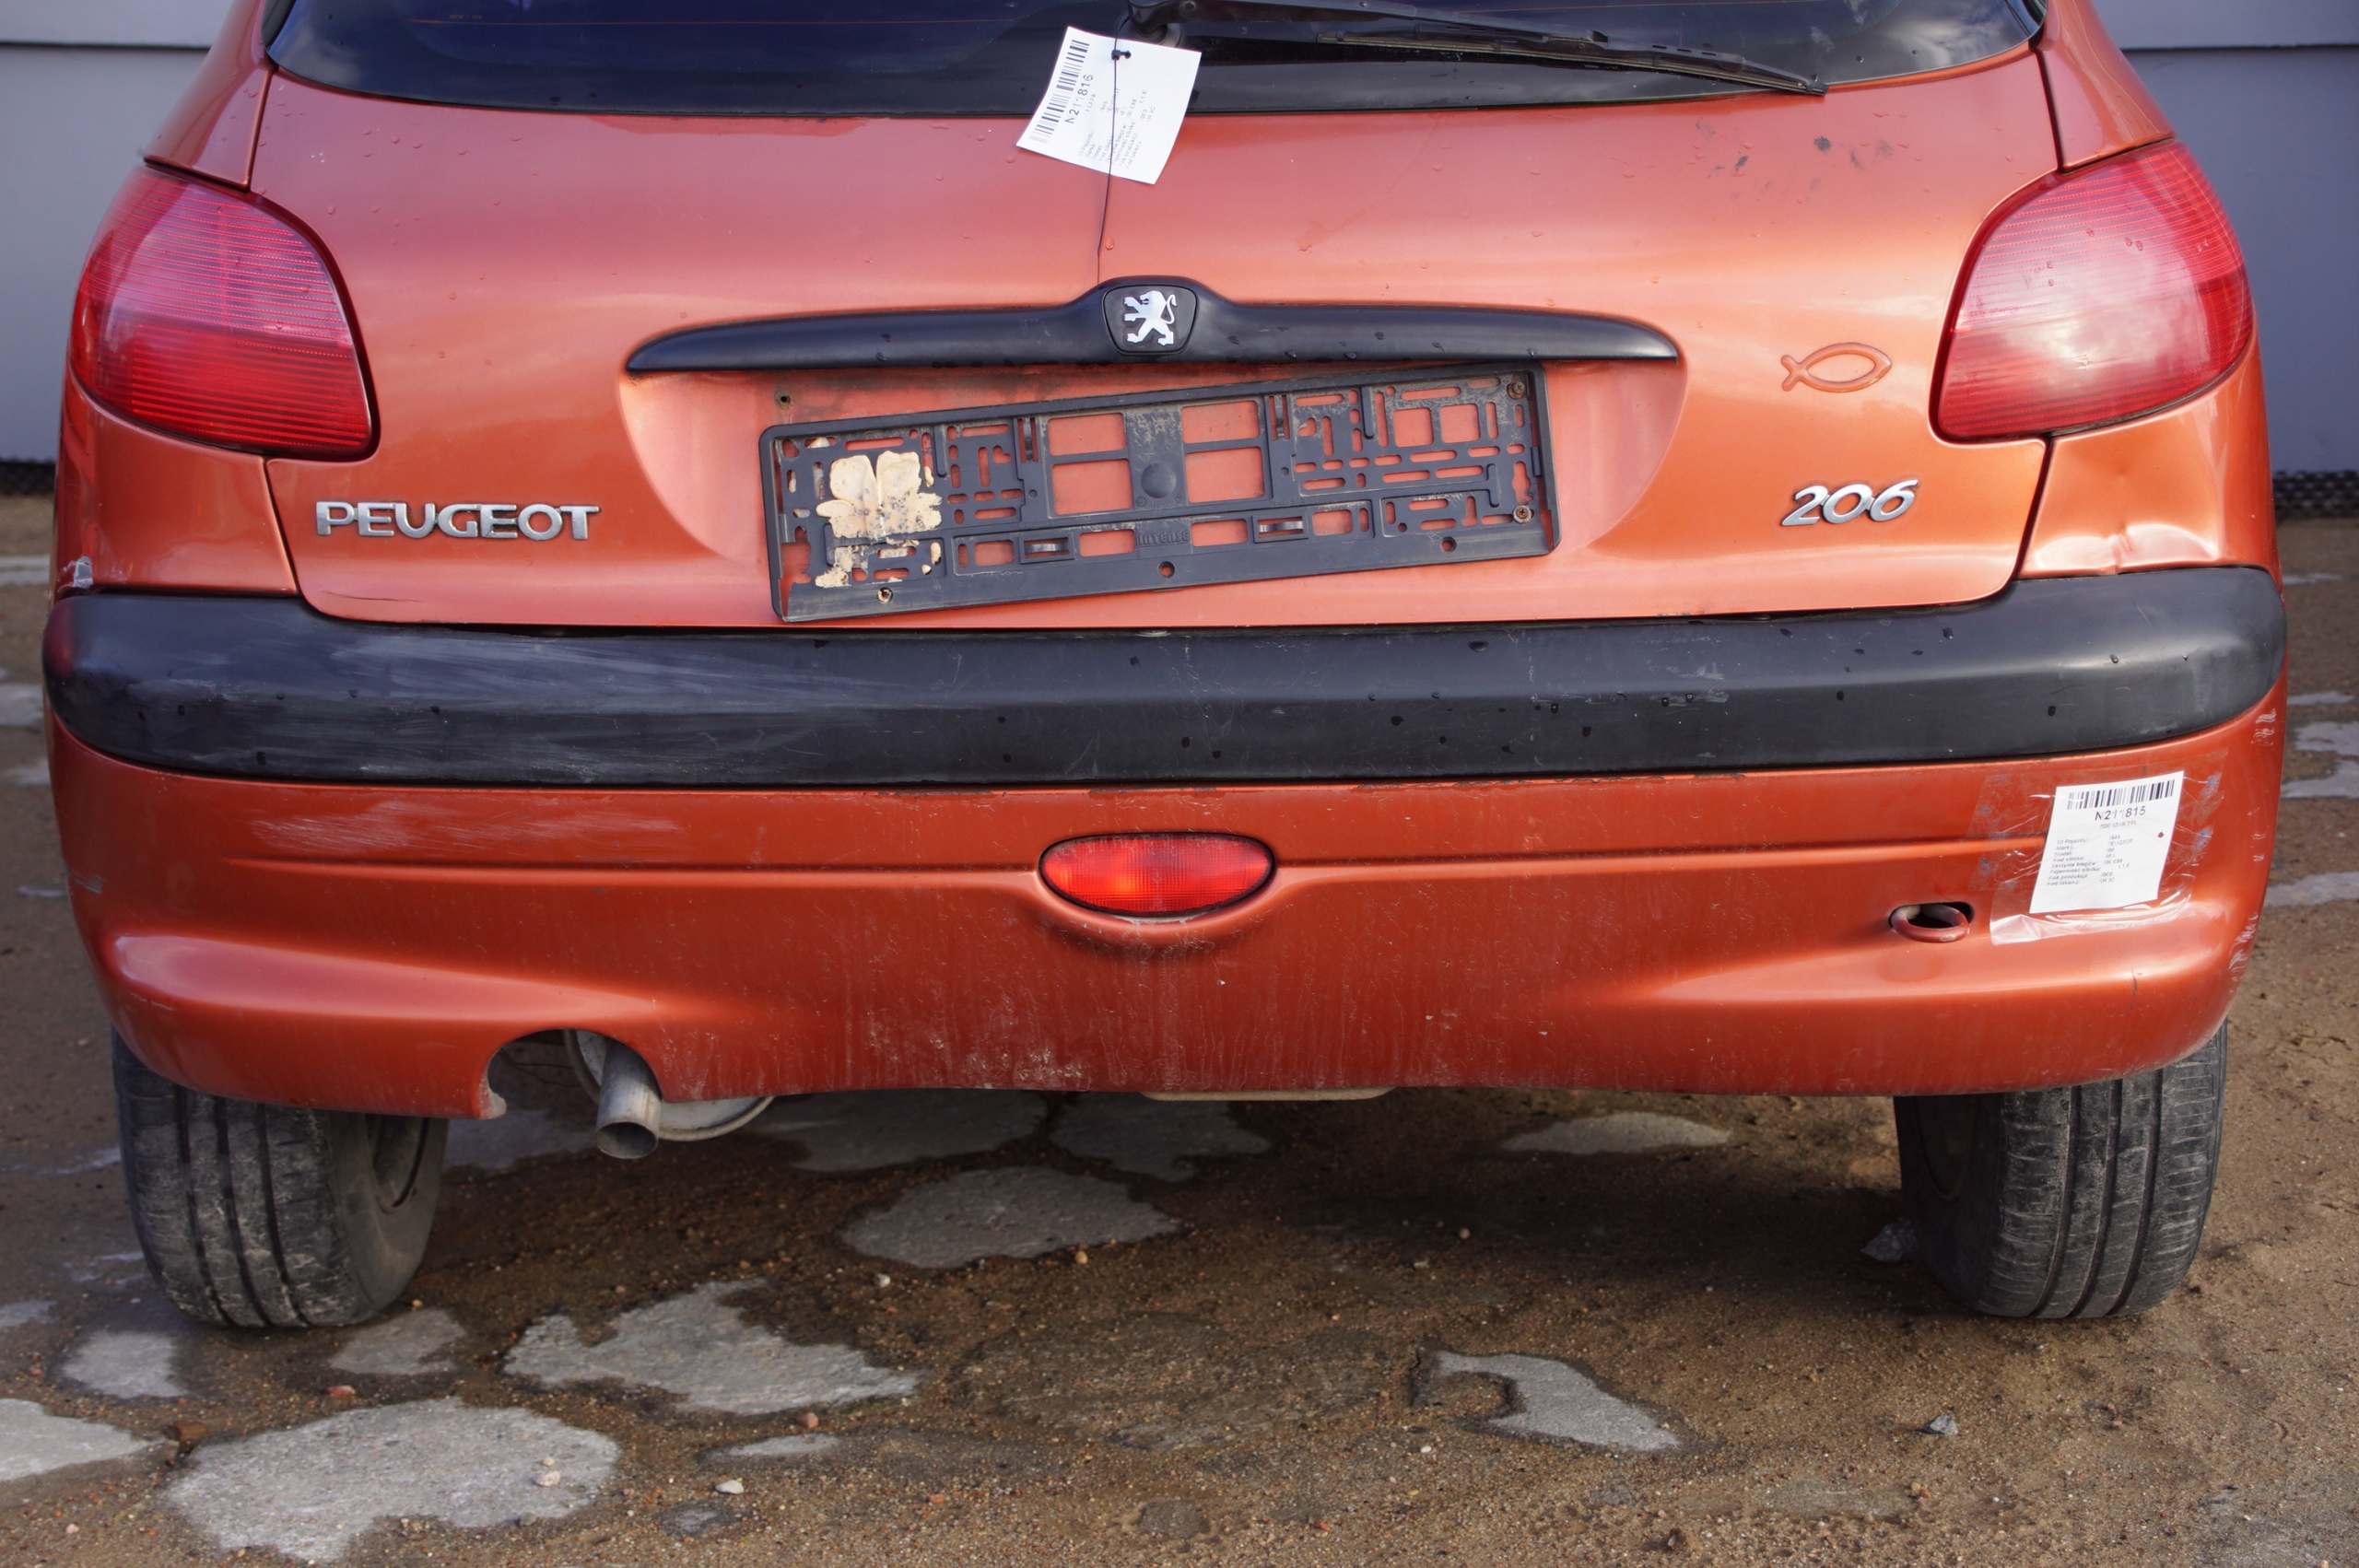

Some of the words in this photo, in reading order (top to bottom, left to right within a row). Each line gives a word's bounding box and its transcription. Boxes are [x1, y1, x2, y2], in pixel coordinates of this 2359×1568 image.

[1064, 75, 1093, 123] N211816
[315, 501, 601, 541] PEUGEOT
[1780, 479, 1919, 527] 206
[2095, 805, 2146, 821] N211815
